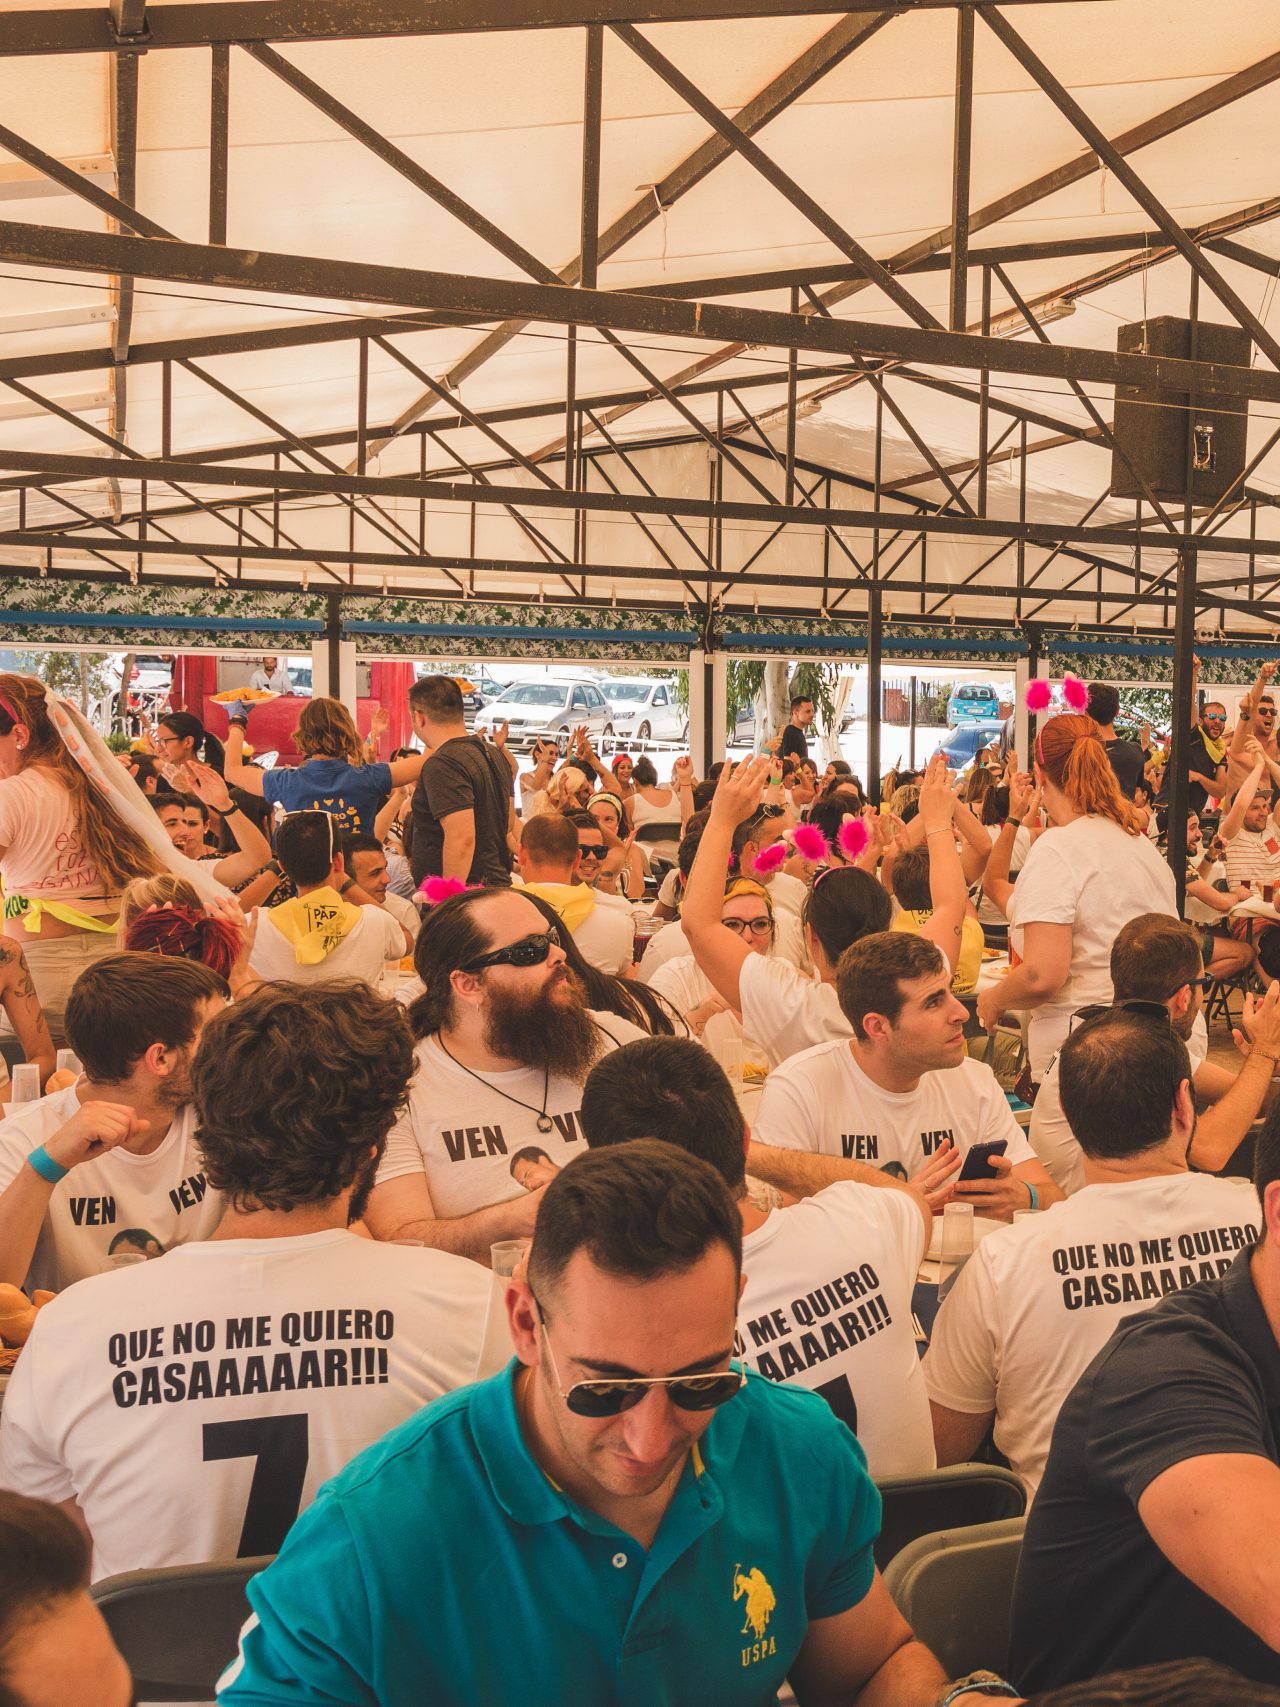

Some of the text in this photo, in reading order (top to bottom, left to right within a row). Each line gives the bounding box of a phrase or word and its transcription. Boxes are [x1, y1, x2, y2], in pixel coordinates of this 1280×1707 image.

[441, 1125, 508, 1162] VEN
[841, 1134, 879, 1160] VEN
[69, 1196, 116, 1226] VEN
[1052, 1223, 1259, 1276] QUE NO ME QUIERO
[747, 1308, 792, 1348] ME
[790, 1263, 880, 1327] QUIERO
[108, 1309, 394, 1368] QUE NO ME QUIERO
[112, 1347, 389, 1409] CASAAAAAR!!!
[202, 1413, 309, 1559] 7
[741, 1636, 777, 1667] USPA
